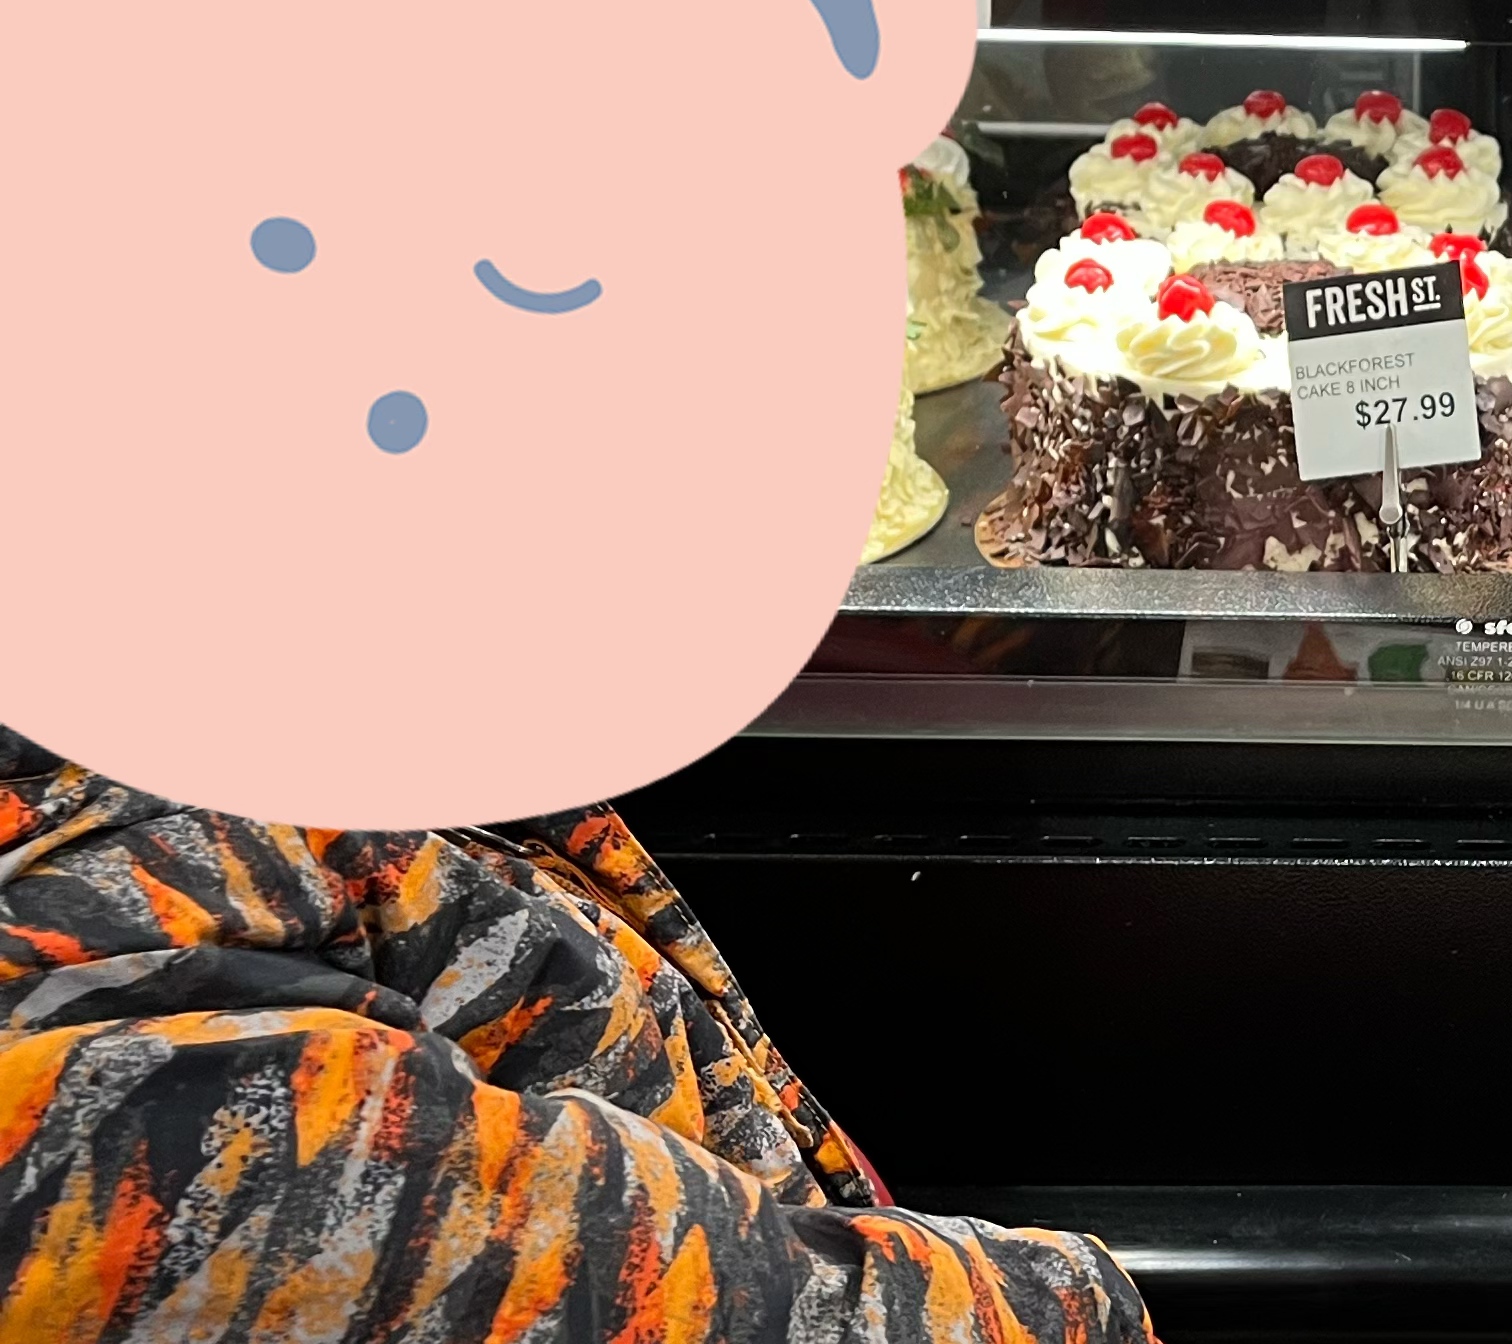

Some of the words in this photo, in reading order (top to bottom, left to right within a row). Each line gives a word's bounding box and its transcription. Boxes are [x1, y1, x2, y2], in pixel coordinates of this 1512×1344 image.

[1306, 277, 1409, 328] FRESH
[1296, 352, 1415, 380] BLACKFOREST
[1297, 381, 1342, 400] CAKE
[1346, 380, 1355, 394] 8
[1360, 375, 1400, 392] INCH
[1355, 391, 1455, 430] $27.99
[1437, 656, 1467, 667] ANSI
[1451, 670, 1464, 681] 16
[1467, 670, 1494, 681] CFR
